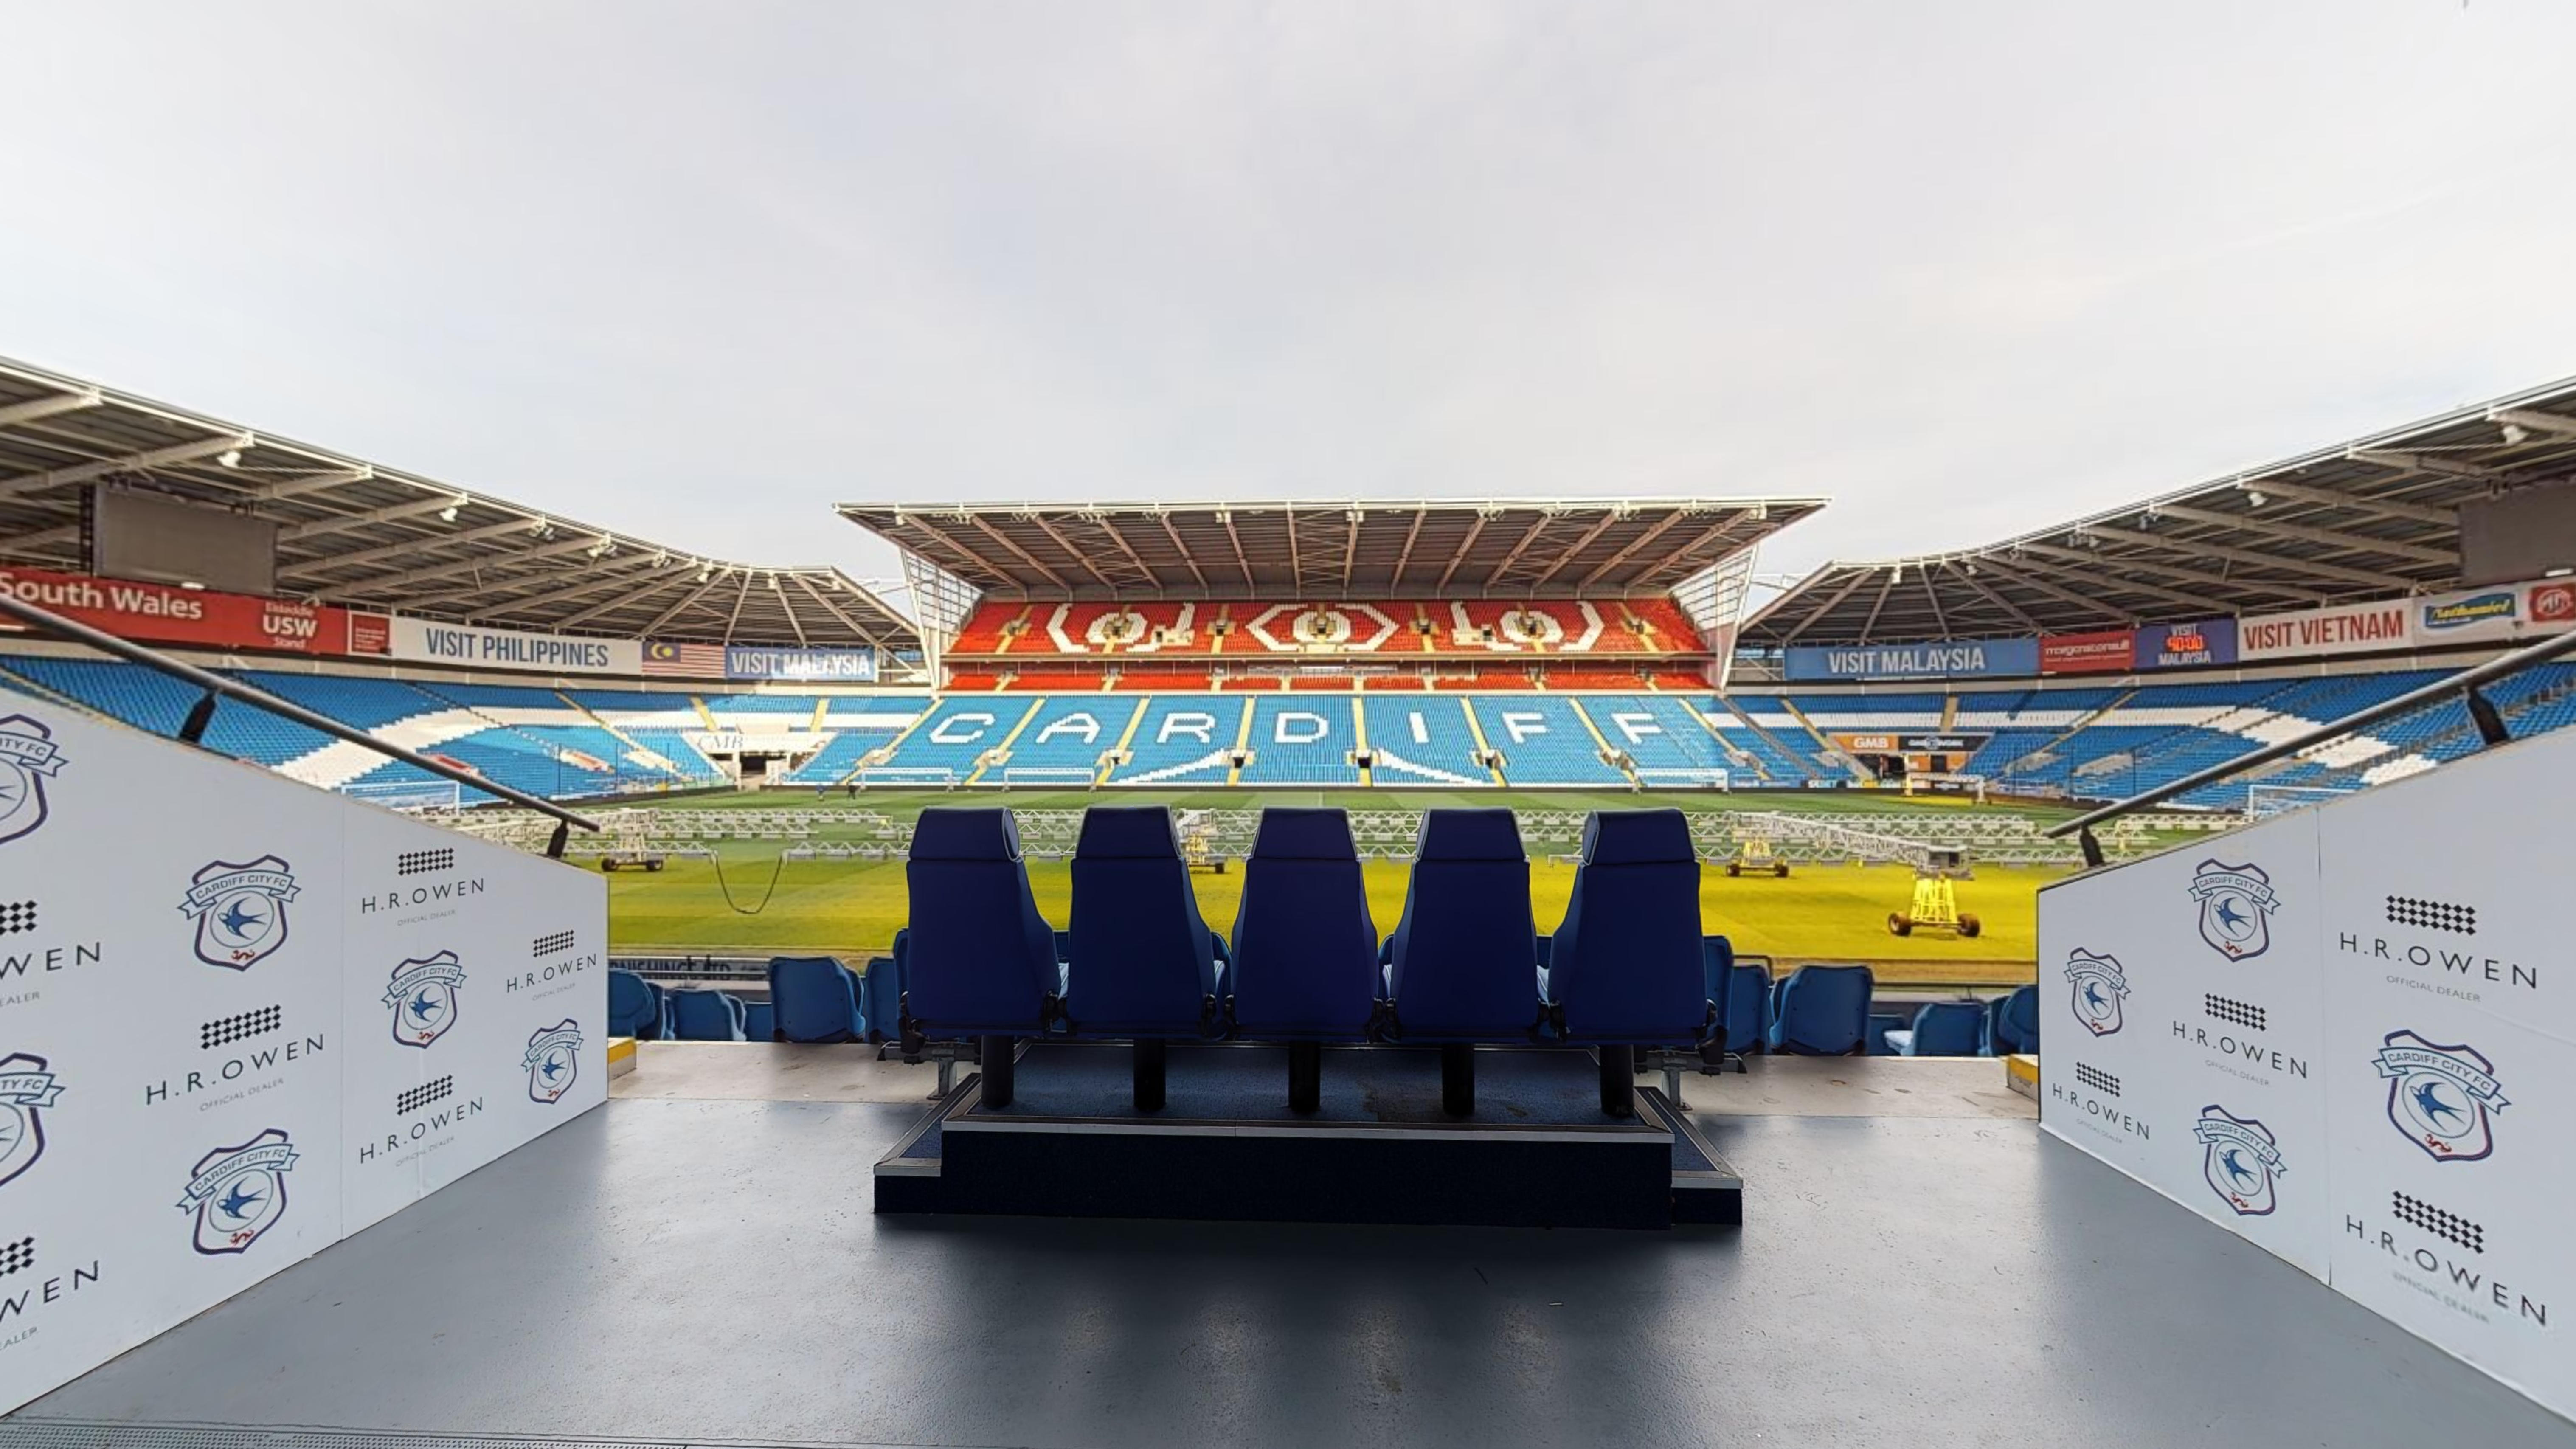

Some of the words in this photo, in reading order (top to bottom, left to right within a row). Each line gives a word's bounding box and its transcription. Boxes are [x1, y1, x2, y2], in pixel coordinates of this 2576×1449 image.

[0, 572, 104, 609] South
[109, 586, 202, 620] Wales
[263, 614, 317, 637] USW
[2171, 624, 2197, 636] VISIT
[2244, 622, 2293, 650] VISIT
[2300, 610, 2403, 644] VIETNAM
[427, 628, 476, 658] VISIT
[483, 636, 608, 666] PHILIPPINES
[2158, 650, 2211, 665] MALAYSIA
[732, 653, 778, 674] VISIT
[783, 653, 869, 676] MALAYSIA
[1828, 651, 1876, 673] VISIT
[1882, 648, 1985, 673] MALAYSIA
[930, 712, 1661, 743] CARDIFF
[0, 738, 24, 749] ITY
[26, 743, 46, 756] FC
[1853, 737, 1889, 748] GMB
[196, 876, 245, 899] CARDIFF
[248, 875, 273, 883] CITY
[274, 878, 287, 887] FC
[2199, 877, 2233, 887] CARDIFF
[2235, 878, 2255, 889] CITY
[2256, 886, 2267, 897] FC
[394, 970, 427, 991] CARDIFF
[447, 968, 457, 976] FC
[2386, 975, 2433, 993] OFFICIAL
[2436, 986, 2480, 1002] DEALER
[2388, 1052, 2439, 1065] CARDIFF
[2441, 1060, 2471, 1078] CITY
[2473, 1075, 2491, 1091] FC
[22, 1079, 43, 1090] FC
[2205, 1123, 2238, 1134] CARDIFF
[2241, 1132, 2261, 1146] CITY
[2262, 1145, 2274, 1158] FC
[194, 1157, 245, 1191] CARDIFF
[247, 1149, 272, 1162] CITY
[272, 1149, 286, 1158] FC
